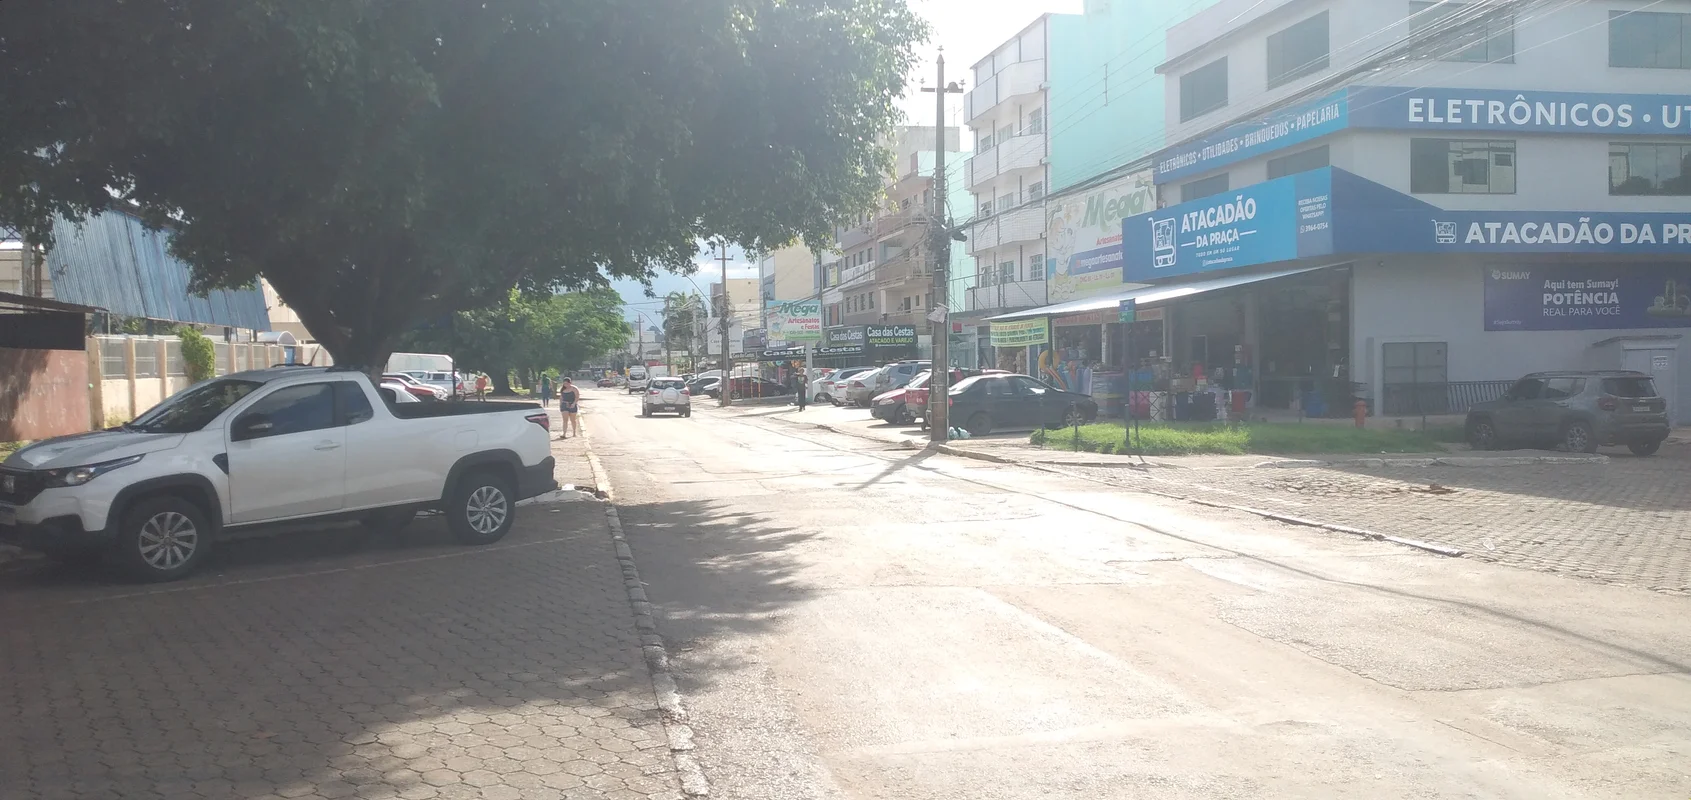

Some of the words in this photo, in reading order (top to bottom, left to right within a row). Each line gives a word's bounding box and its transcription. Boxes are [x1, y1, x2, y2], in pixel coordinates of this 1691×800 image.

[1408, 94, 1633, 128] ELETRÔNICOS
[1159, 151, 1197, 174] ELETRÔNICOS
[1202, 138, 1239, 162] UTILIDADES
[1244, 121, 1289, 148] BRINQUEDOS
[1296, 103, 1340, 131] PAPELARIA
[1081, 188, 1148, 233] Mega
[1181, 194, 1257, 234] ATACADÃO
[1196, 235, 1208, 249] DA
[1209, 227, 1240, 248] PRAÇA
[1465, 217, 1614, 244] ATACADÃO
[1620, 223, 1656, 244] DA
[1662, 223, 1691, 244] PR
[1501, 271, 1531, 280] SUMAY
[1543, 280, 1565, 291] Aqui
[1567, 280, 1585, 289] tem
[1586, 279, 1619, 291] Sumay!
[1543, 289, 1619, 305] POTÊNCIA
[777, 302, 818, 317] Mega
[1543, 307, 1566, 316] REAL
[1568, 307, 1593, 316] PARA
[1595, 305, 1621, 315] VOCÊ
[830, 331, 840, 341] Casa
[839, 330, 847, 340] das
[848, 329, 863, 340] Cestas
[867, 326, 881, 337] Casa
[882, 326, 893, 337] das
[894, 325, 914, 337] Cestas
